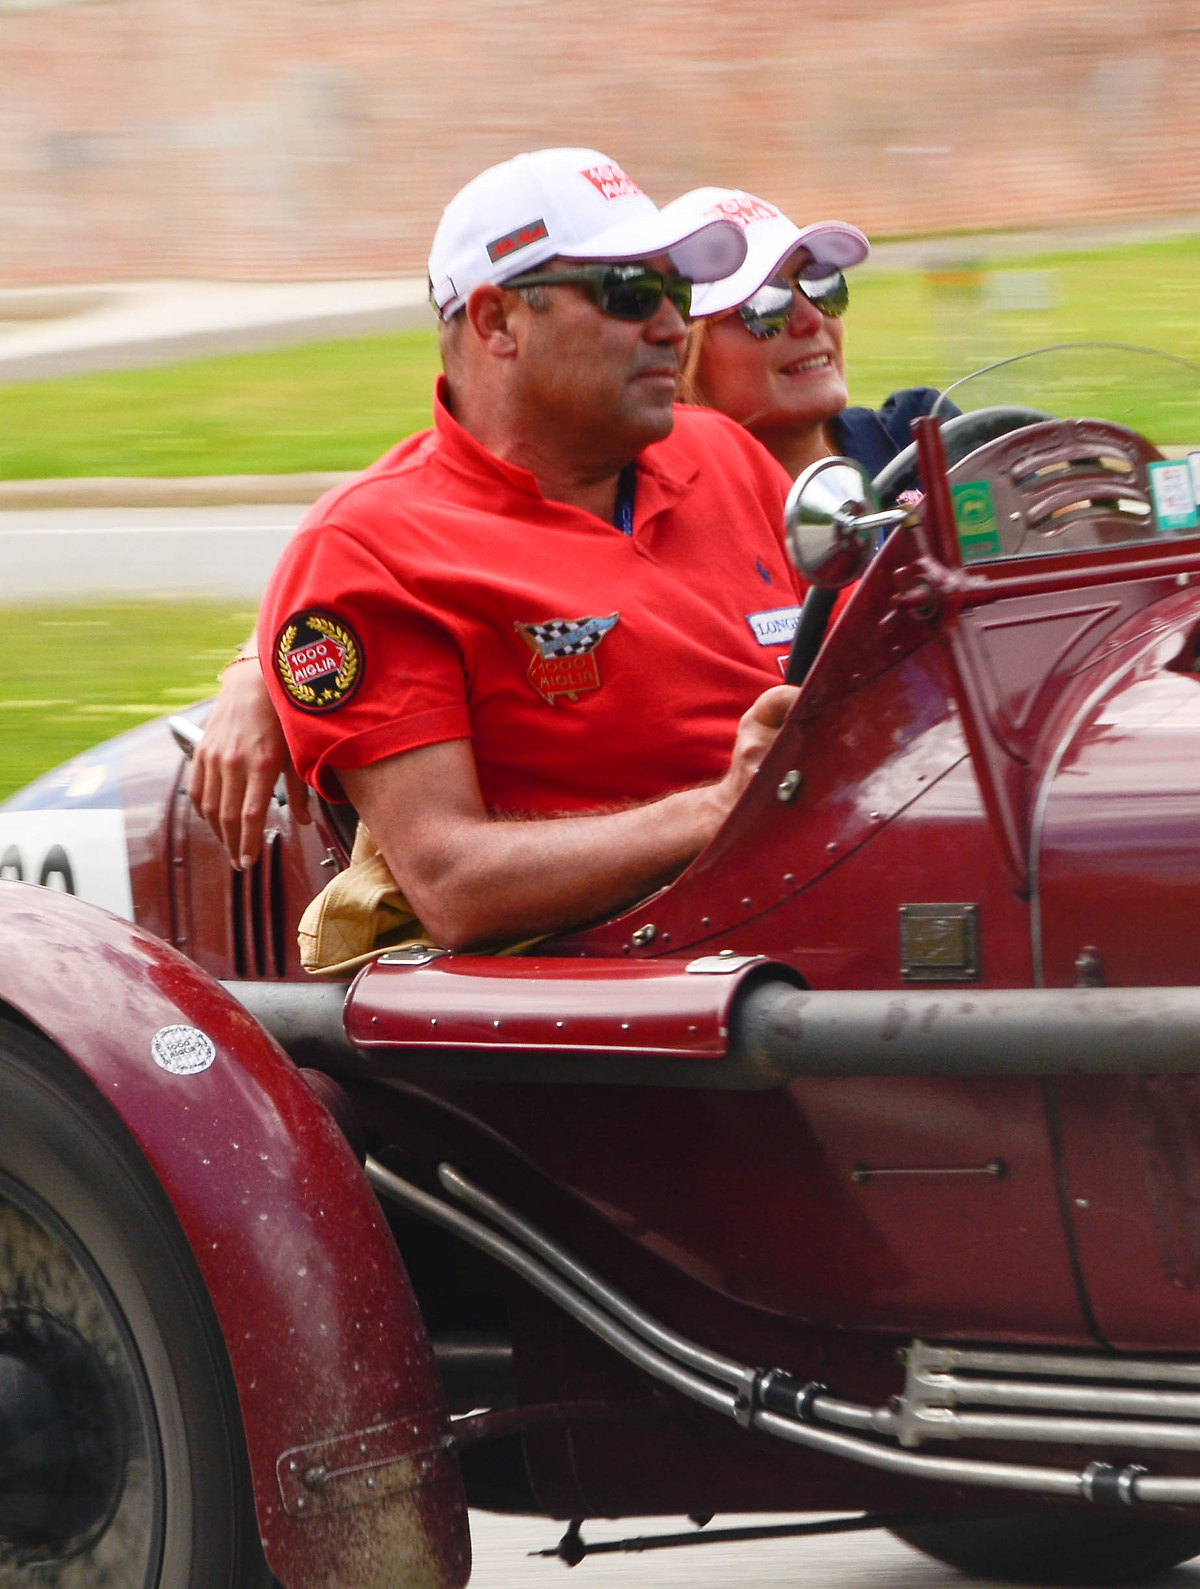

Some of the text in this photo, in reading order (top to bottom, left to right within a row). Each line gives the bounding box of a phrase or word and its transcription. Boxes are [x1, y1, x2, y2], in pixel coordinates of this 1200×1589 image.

[757, 616, 801, 636] LONG
[291, 644, 328, 667] 1000
[538, 656, 586, 675] 1000
[294, 657, 337, 682] MIGLIA
[539, 670, 594, 690] MIGLIA
